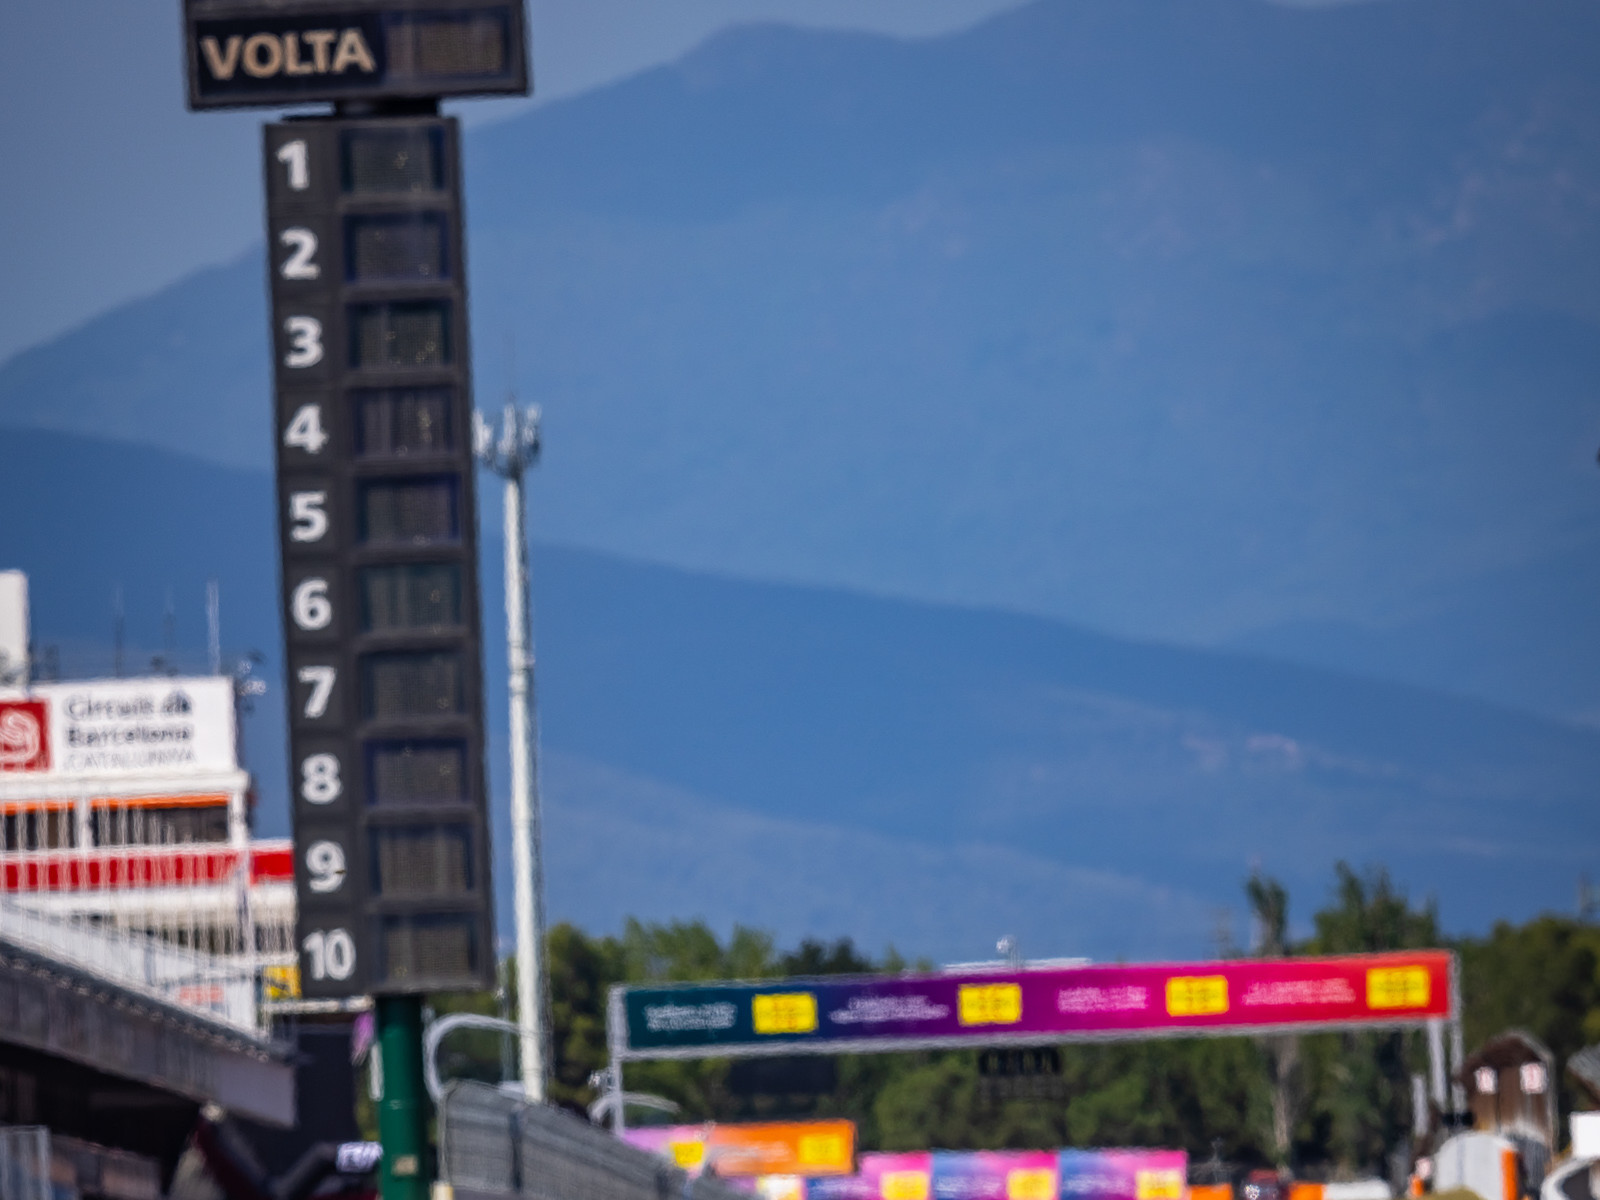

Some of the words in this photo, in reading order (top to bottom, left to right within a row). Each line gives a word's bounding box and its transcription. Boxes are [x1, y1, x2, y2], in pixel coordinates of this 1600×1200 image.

[204, 31, 373, 78] VOLTA
[278, 141, 308, 189] 1
[281, 229, 319, 278] 2
[286, 316, 323, 367] 3
[285, 405, 328, 453] 4
[290, 492, 328, 542] 5
[292, 579, 332, 630] 6
[65, 694, 154, 719] Circuit
[298, 666, 335, 718] 7
[67, 723, 193, 748] Barcelona
[302, 754, 341, 804] 8
[306, 841, 345, 892] 9
[303, 929, 356, 980] 10
